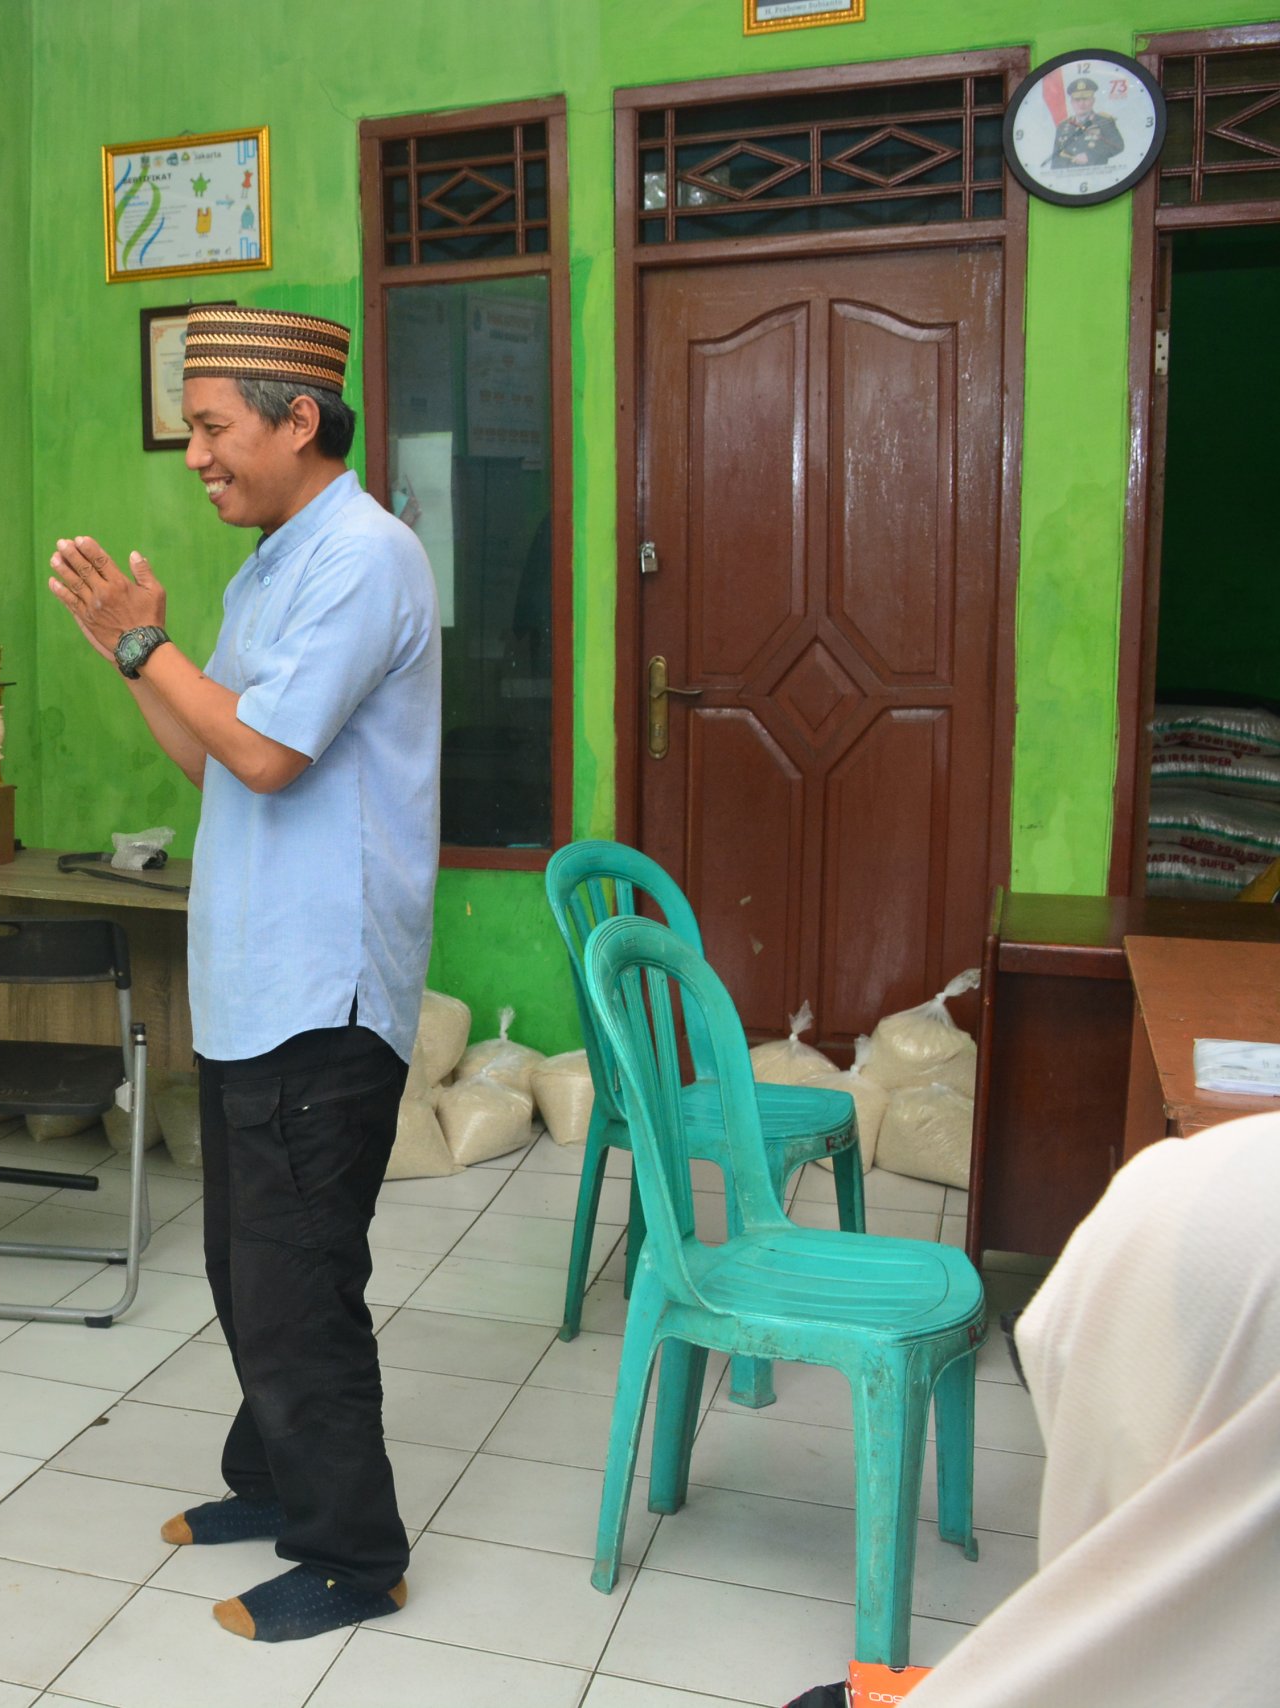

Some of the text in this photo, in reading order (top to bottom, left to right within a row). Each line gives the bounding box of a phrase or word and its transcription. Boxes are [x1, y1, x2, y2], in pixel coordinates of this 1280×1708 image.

[1076, 63, 1091, 75] 12
[1109, 79, 1128, 95] 73
[1145, 117, 1154, 128] 3
[1015, 129, 1024, 140] 9
[1079, 182, 1088, 193] 6
[1198, 754, 1232, 767] SUPER
[1200, 857, 1236, 872] SUPER
